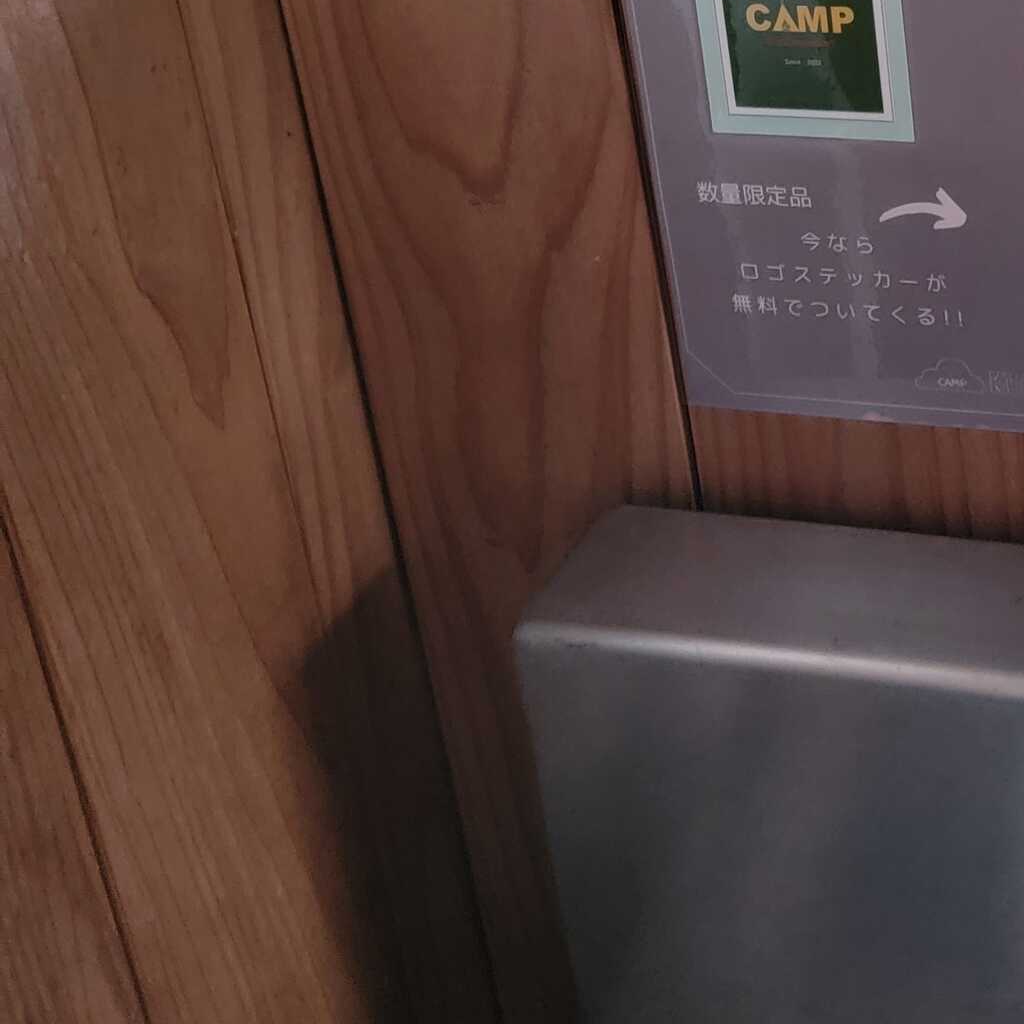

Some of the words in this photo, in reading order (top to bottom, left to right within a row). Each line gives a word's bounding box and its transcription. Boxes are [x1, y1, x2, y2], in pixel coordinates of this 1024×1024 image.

[745, 0, 855, 34] CAMP
[697, 181, 812, 208] 数量限定品
[801, 231, 873, 254] 今なら
[740, 262, 947, 293] ロゴステッカーが
[731, 293, 964, 327] 無料でついてくる!!
